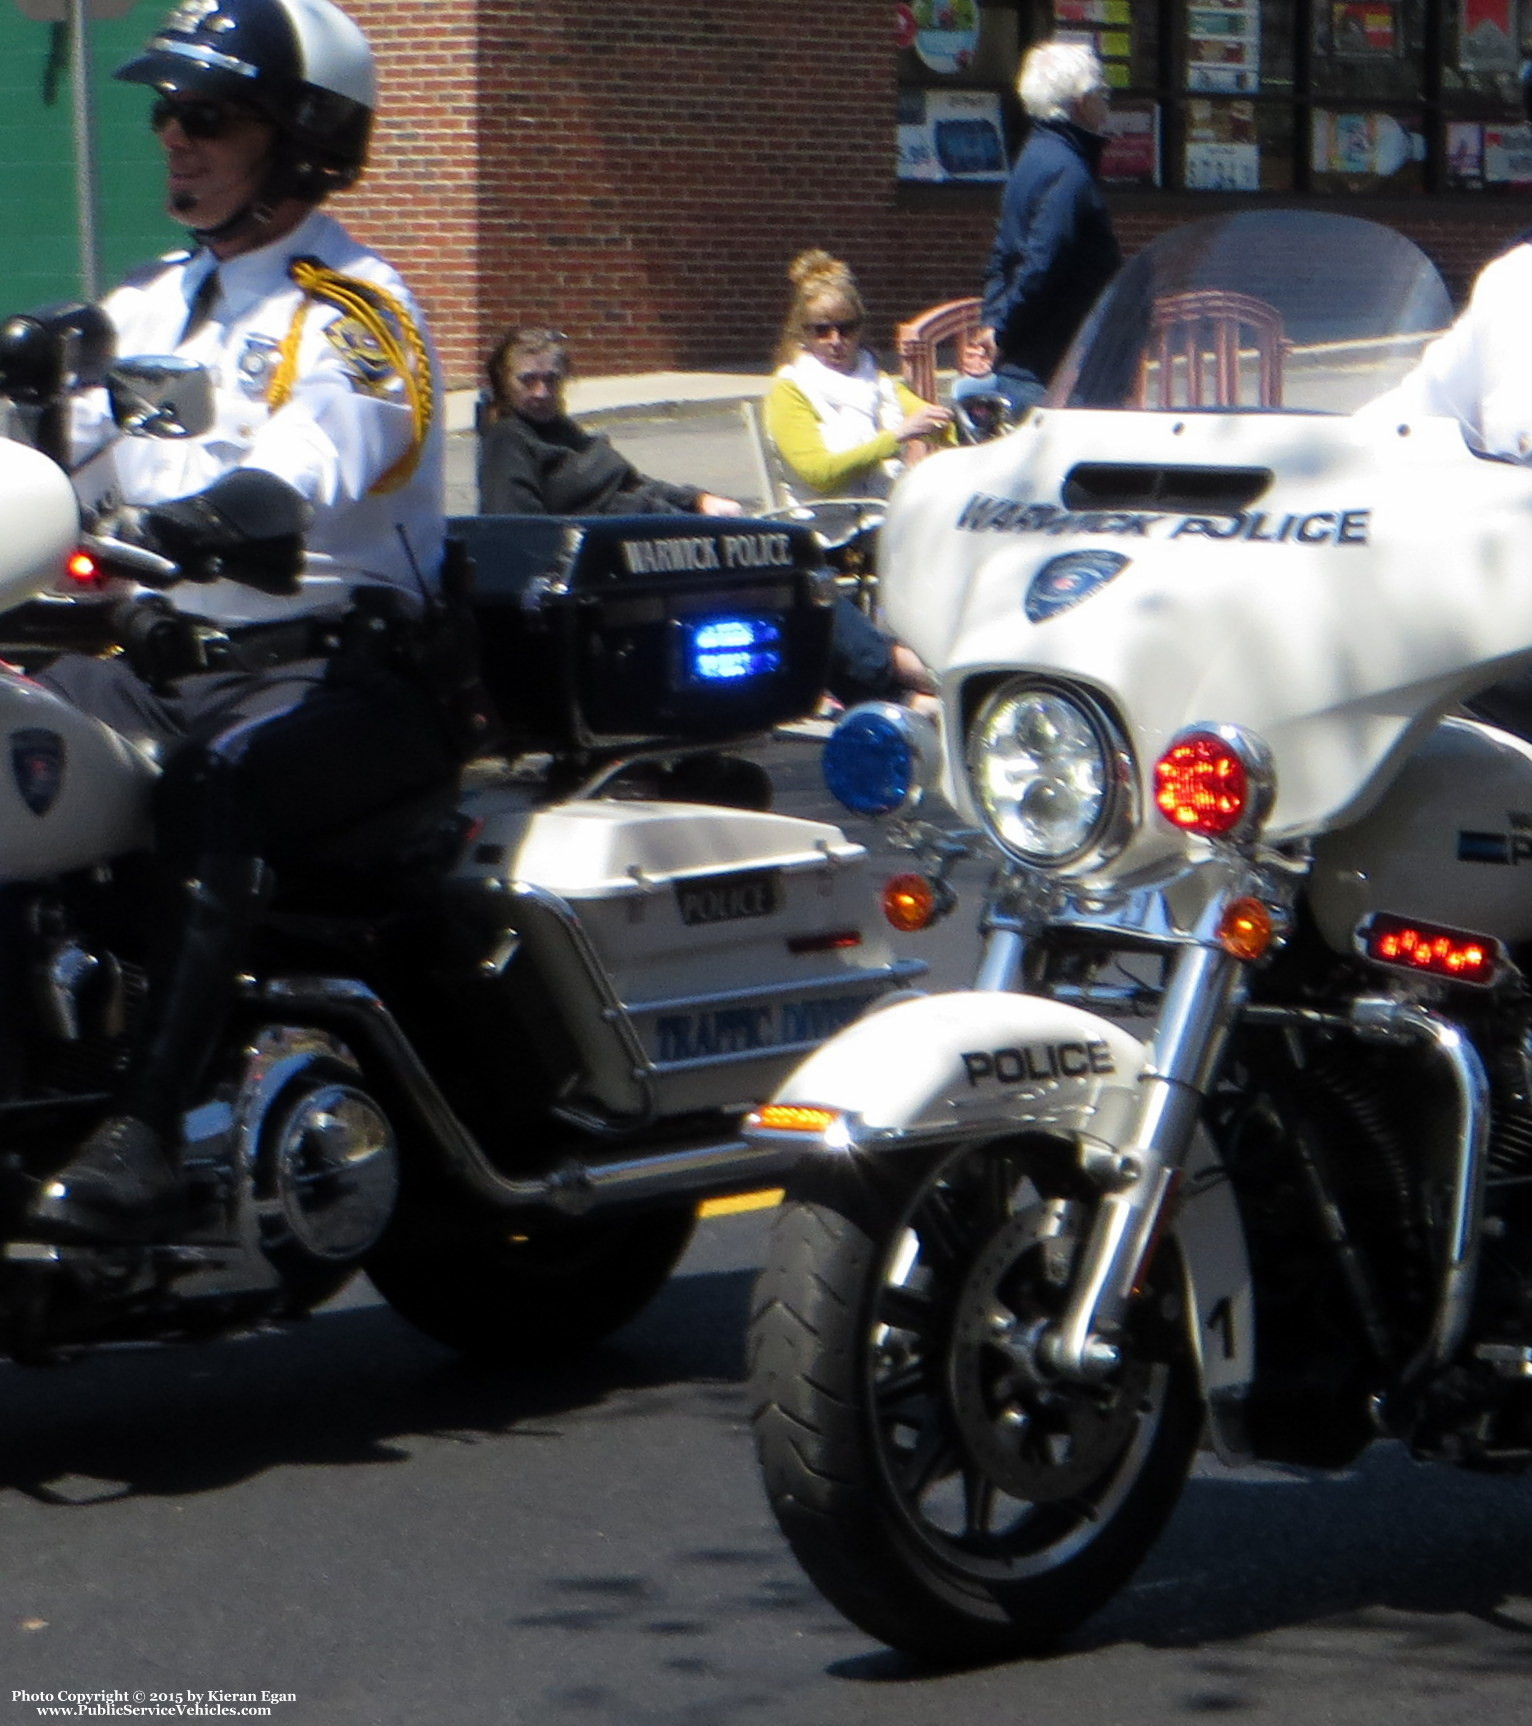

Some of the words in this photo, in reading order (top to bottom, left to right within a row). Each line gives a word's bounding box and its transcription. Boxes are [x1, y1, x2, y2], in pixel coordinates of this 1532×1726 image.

[1168, 508, 1374, 546] POLICE
[622, 537, 720, 574] WARWICK
[721, 533, 793, 568] POLICE
[684, 880, 771, 922] POLICE
[960, 1040, 1116, 1087] POLICE
[1205, 1296, 1234, 1359] 1
